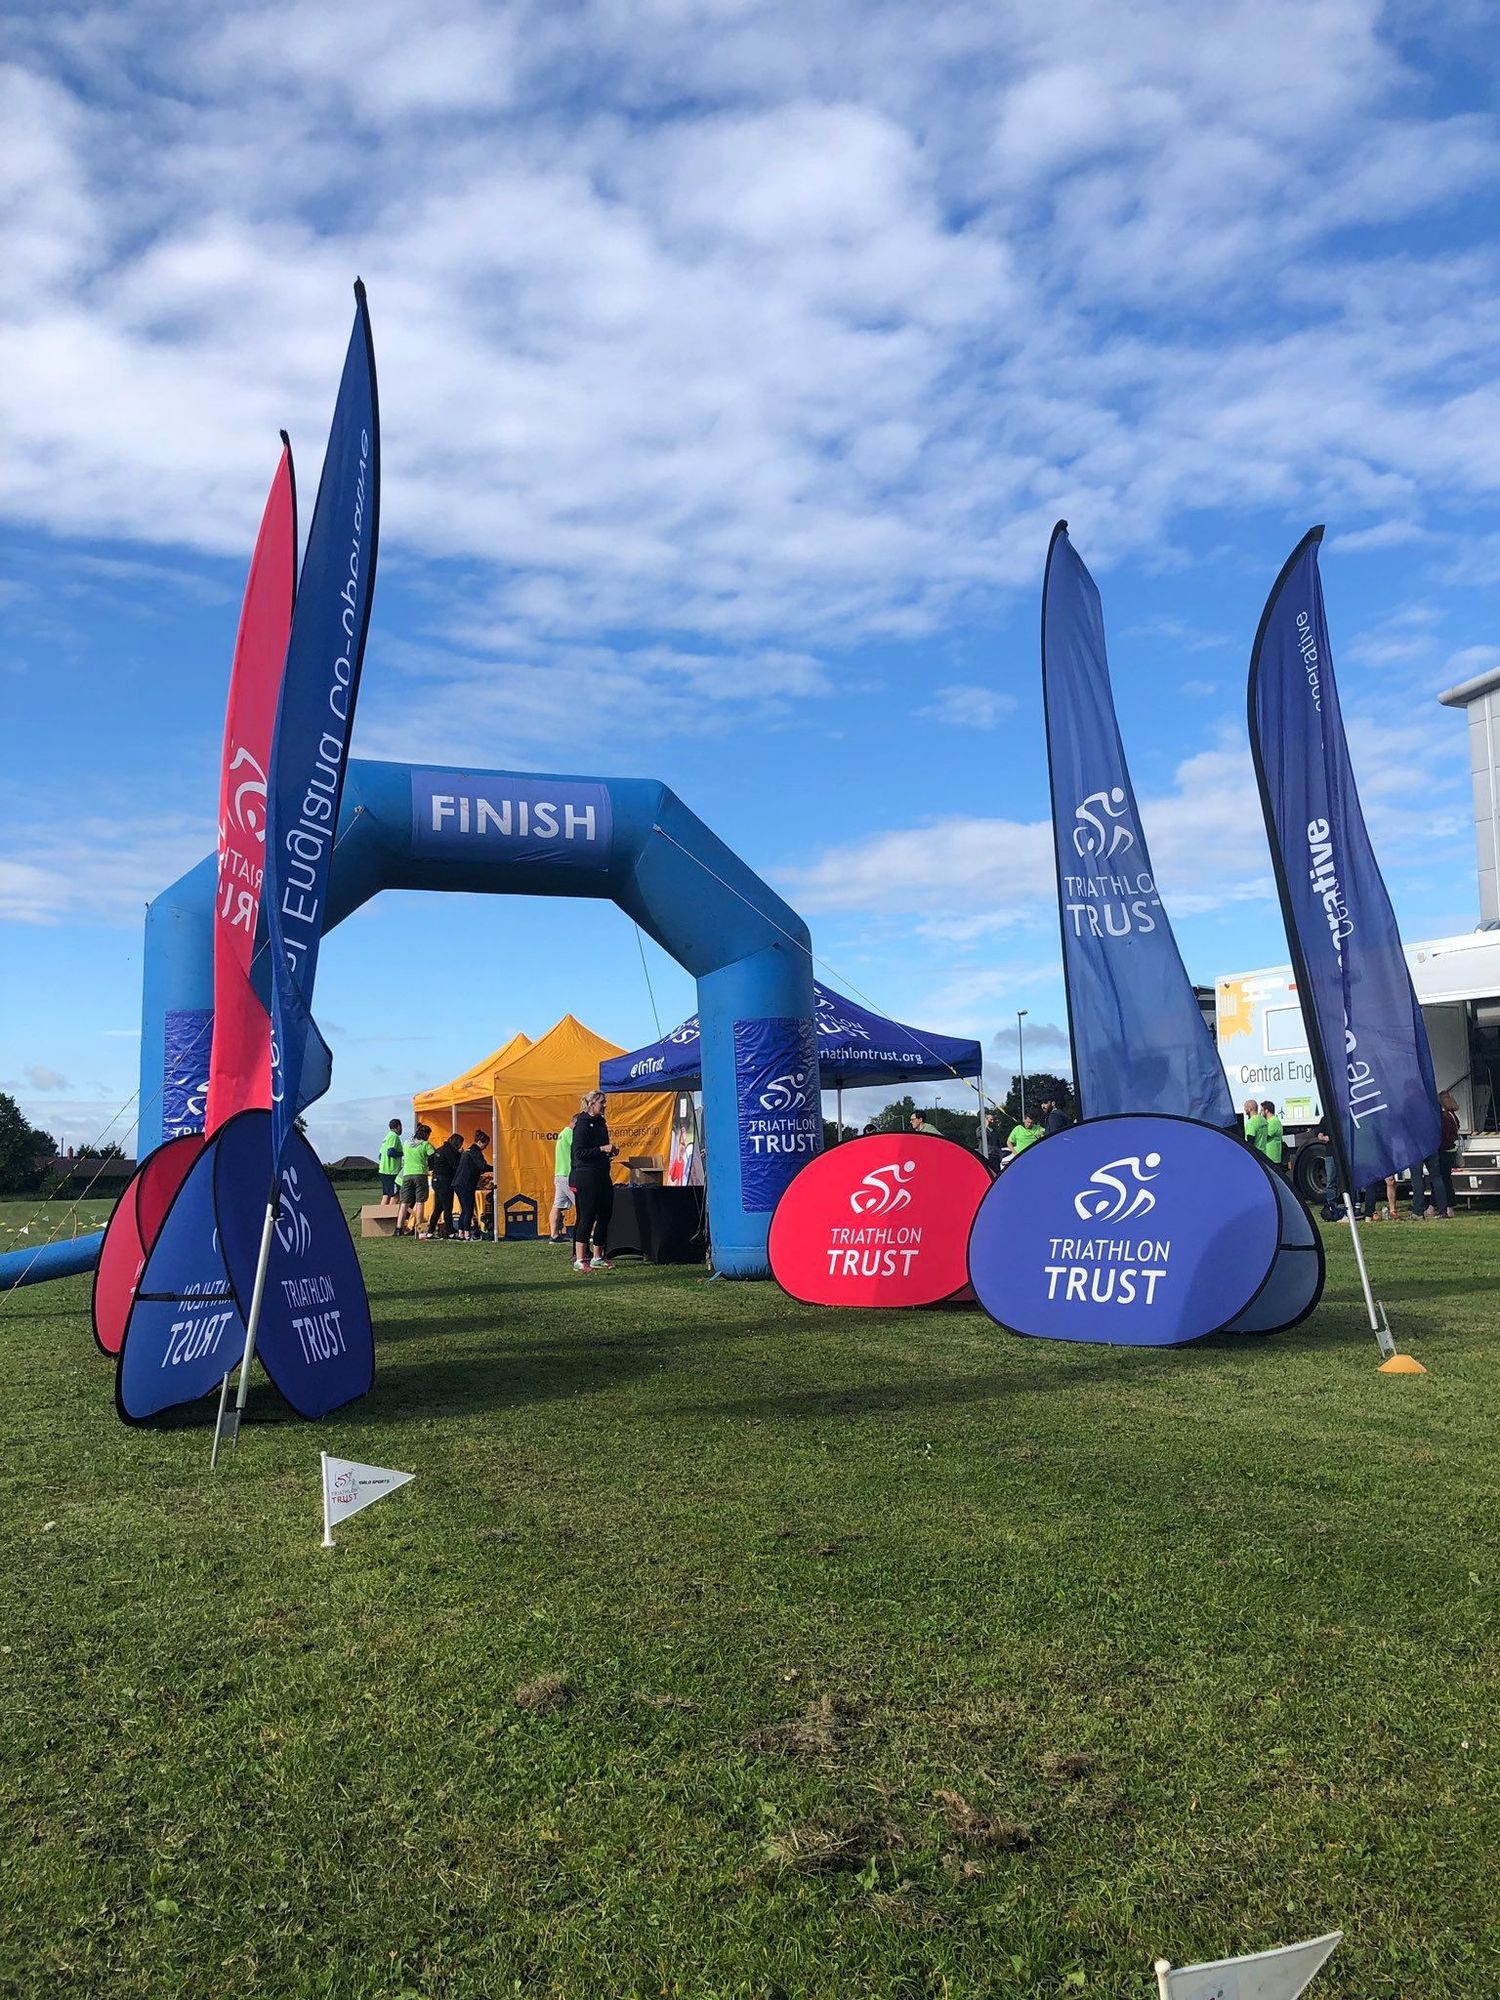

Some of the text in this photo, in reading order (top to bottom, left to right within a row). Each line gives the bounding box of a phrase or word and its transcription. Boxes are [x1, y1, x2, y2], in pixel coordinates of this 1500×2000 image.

[431, 794, 596, 841] FINISH
[1064, 873, 1157, 898] TRIATHLO
[818, 1047, 924, 1065] riathlontrust.org
[1240, 1060, 1316, 1084] Central Eng
[530, 1130, 546, 1141] The
[749, 1119, 816, 1132] TRIATHLON
[749, 1133, 816, 1154] TRUST
[831, 1227, 922, 1245] TRIATHLON
[1048, 1238, 1171, 1263] TRIATHLON
[826, 1249, 920, 1277] TRUST
[281, 1275, 336, 1309] TRIATHLON
[1043, 1266, 1167, 1305] TRUST
[291, 1310, 347, 1365] TRUST
[331, 1492, 359, 1504] TRUST
